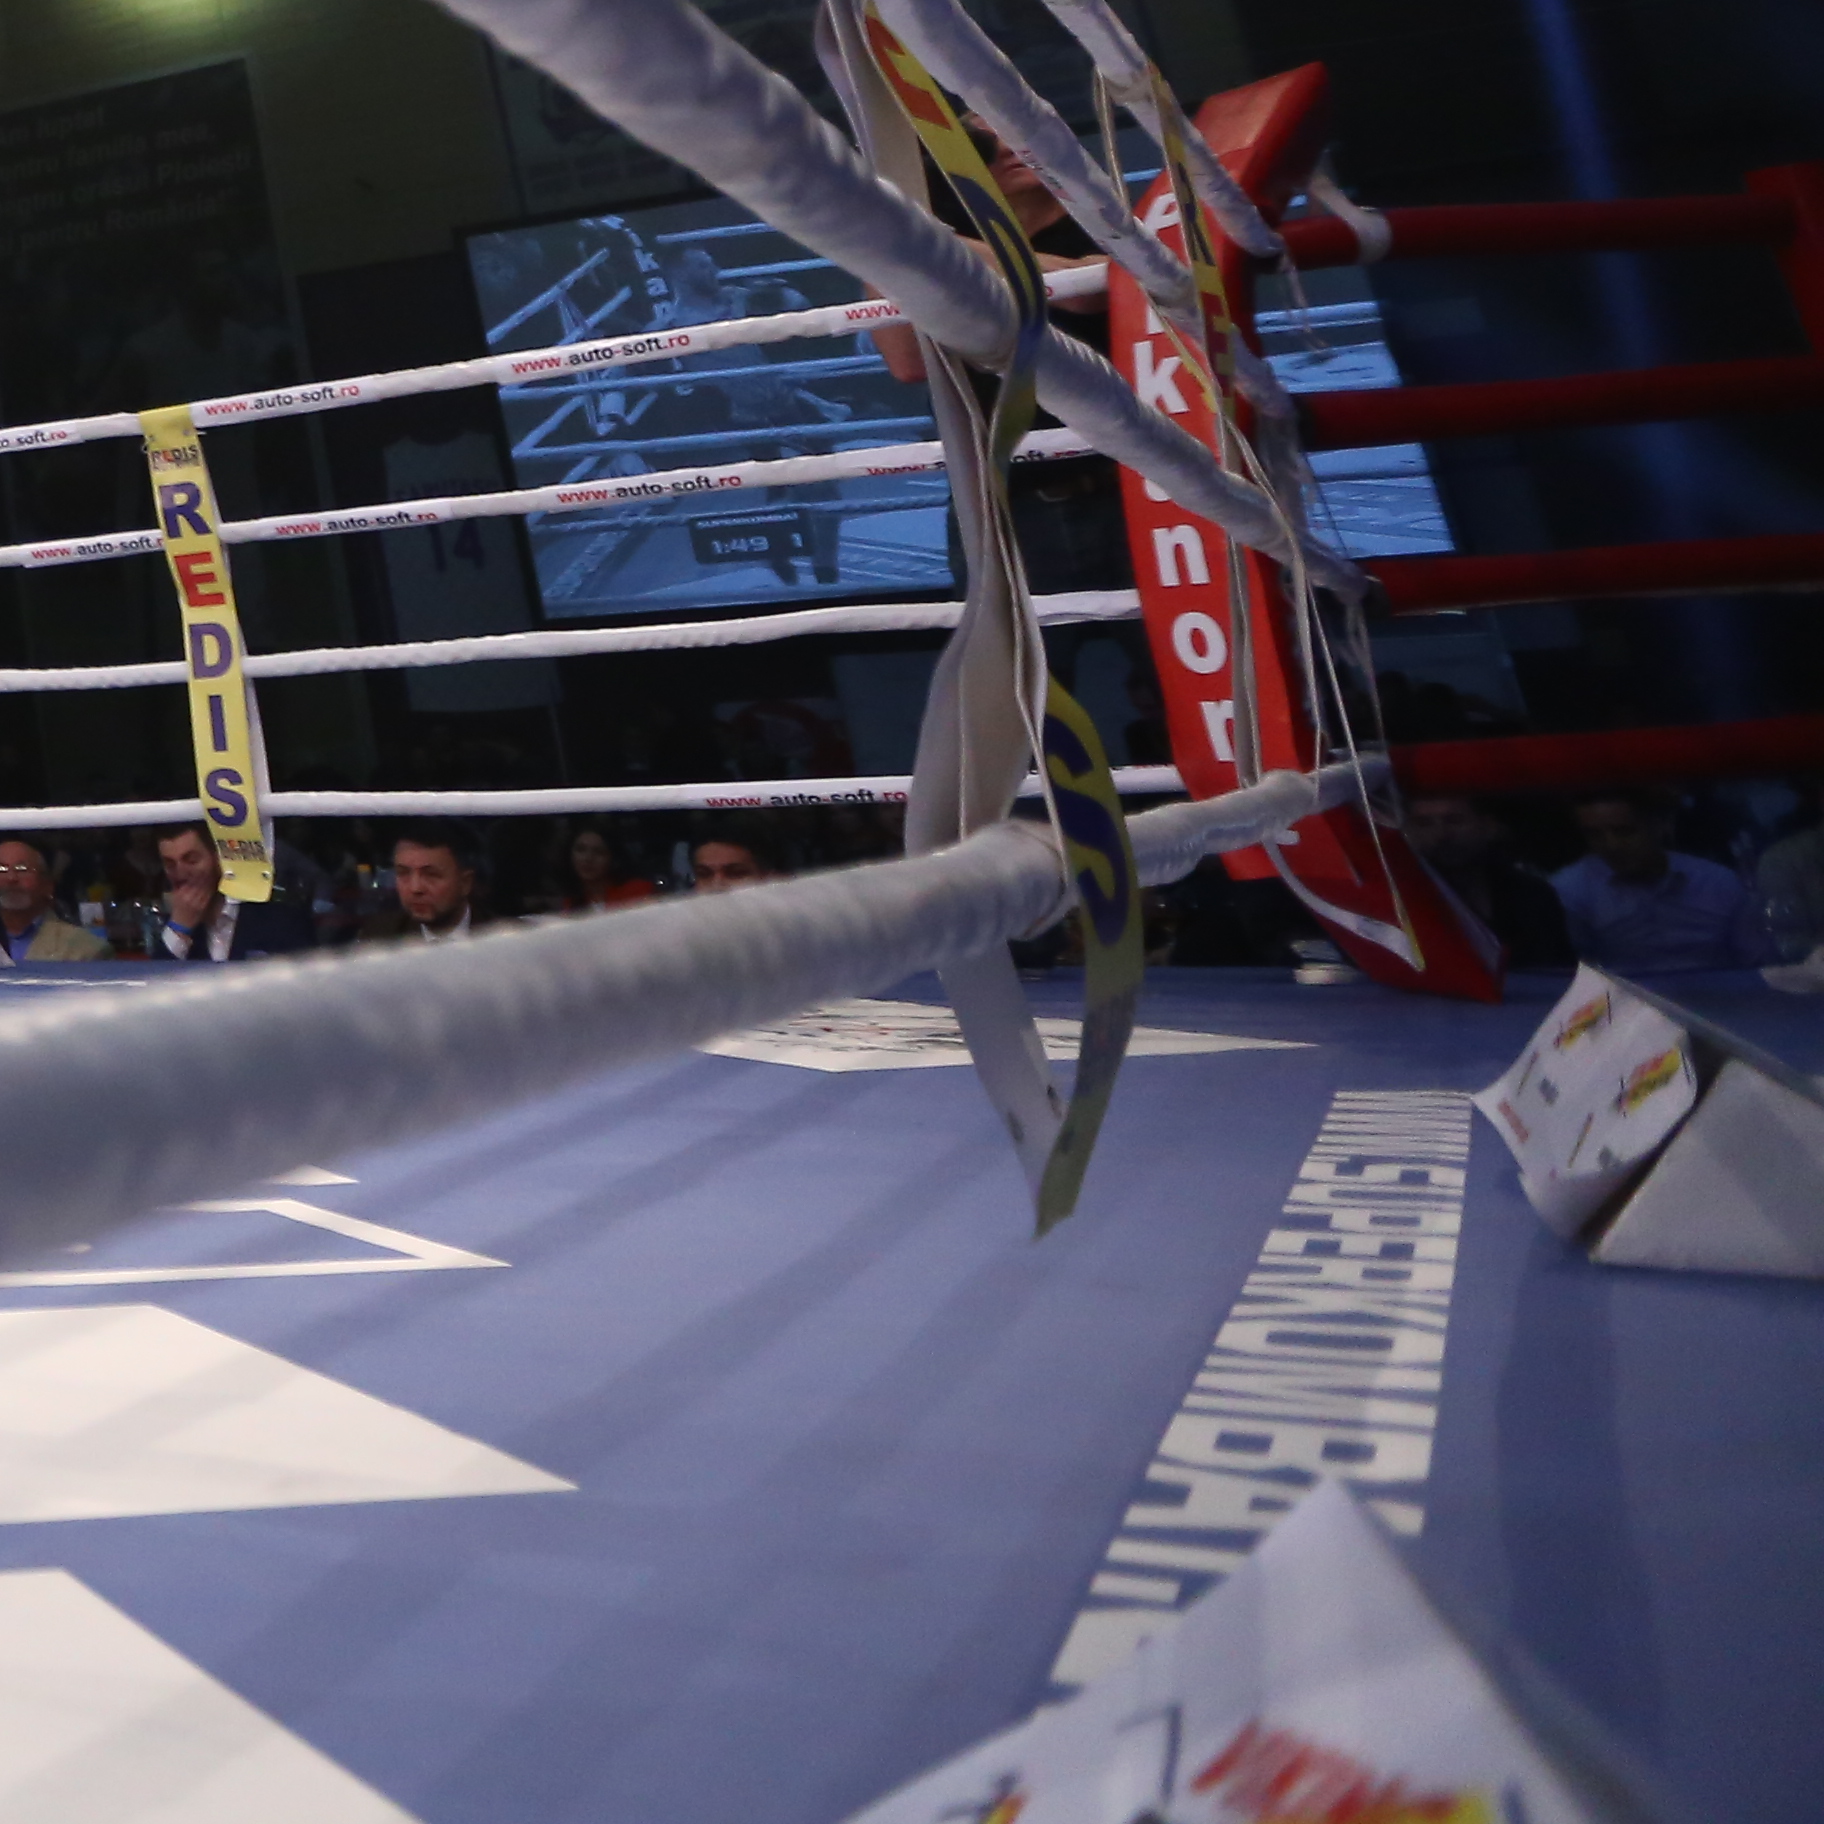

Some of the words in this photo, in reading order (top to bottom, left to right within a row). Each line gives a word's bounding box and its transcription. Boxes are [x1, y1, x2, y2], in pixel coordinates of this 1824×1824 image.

[512, 331, 692, 376] www.auto-soft.ro
[204, 383, 360, 416] www.auto-soft.ro
[557, 474, 745, 505] www.auto-soft.ro
[275, 509, 438, 537] www.auto-soft.ro
[159, 480, 249, 827] REDIS
